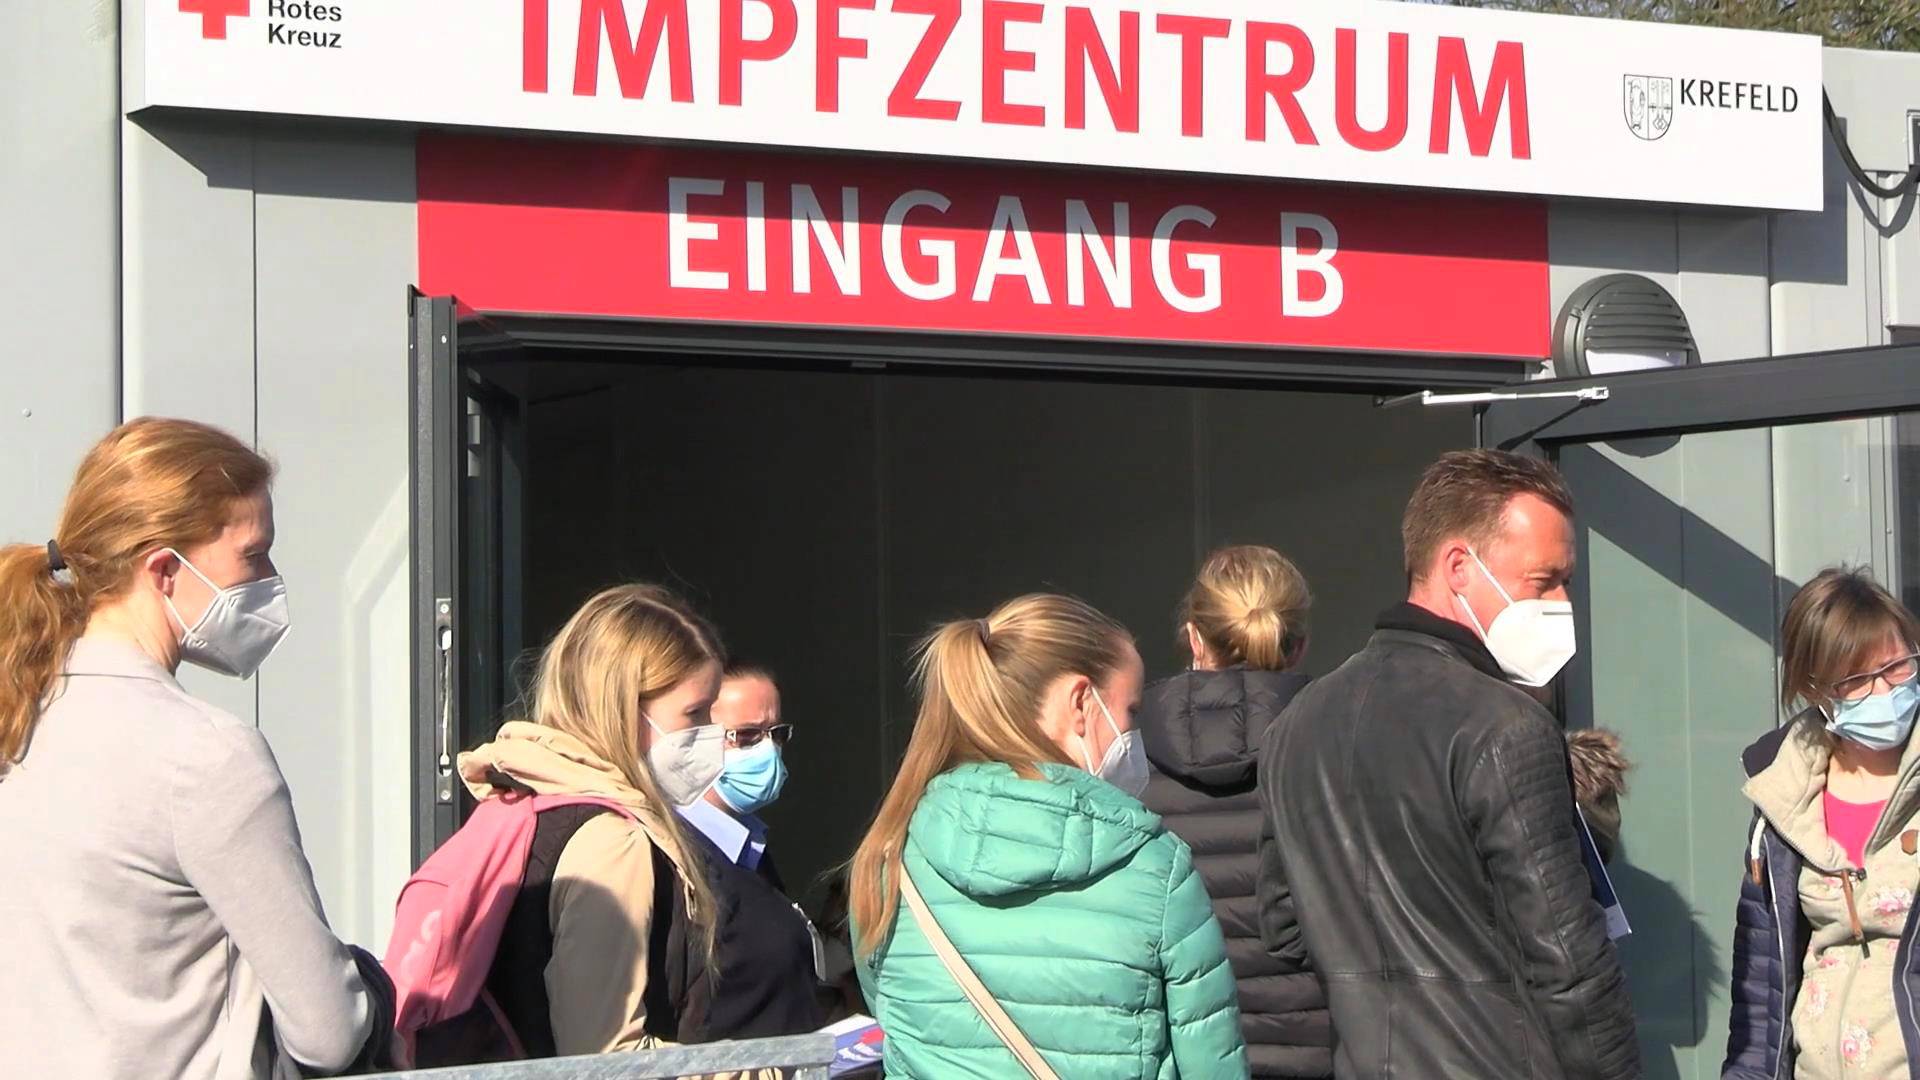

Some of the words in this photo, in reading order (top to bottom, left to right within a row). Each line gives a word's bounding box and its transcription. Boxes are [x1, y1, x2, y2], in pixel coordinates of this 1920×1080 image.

[268, 0, 342, 22] Rotes
[268, 23, 342, 49] Kreuz
[522, 0, 1531, 160] IMPFZENTRUM
[1680, 78, 1798, 113] KREFELD
[667, 176, 1222, 314] EINGANG
[1280, 211, 1344, 318] B
